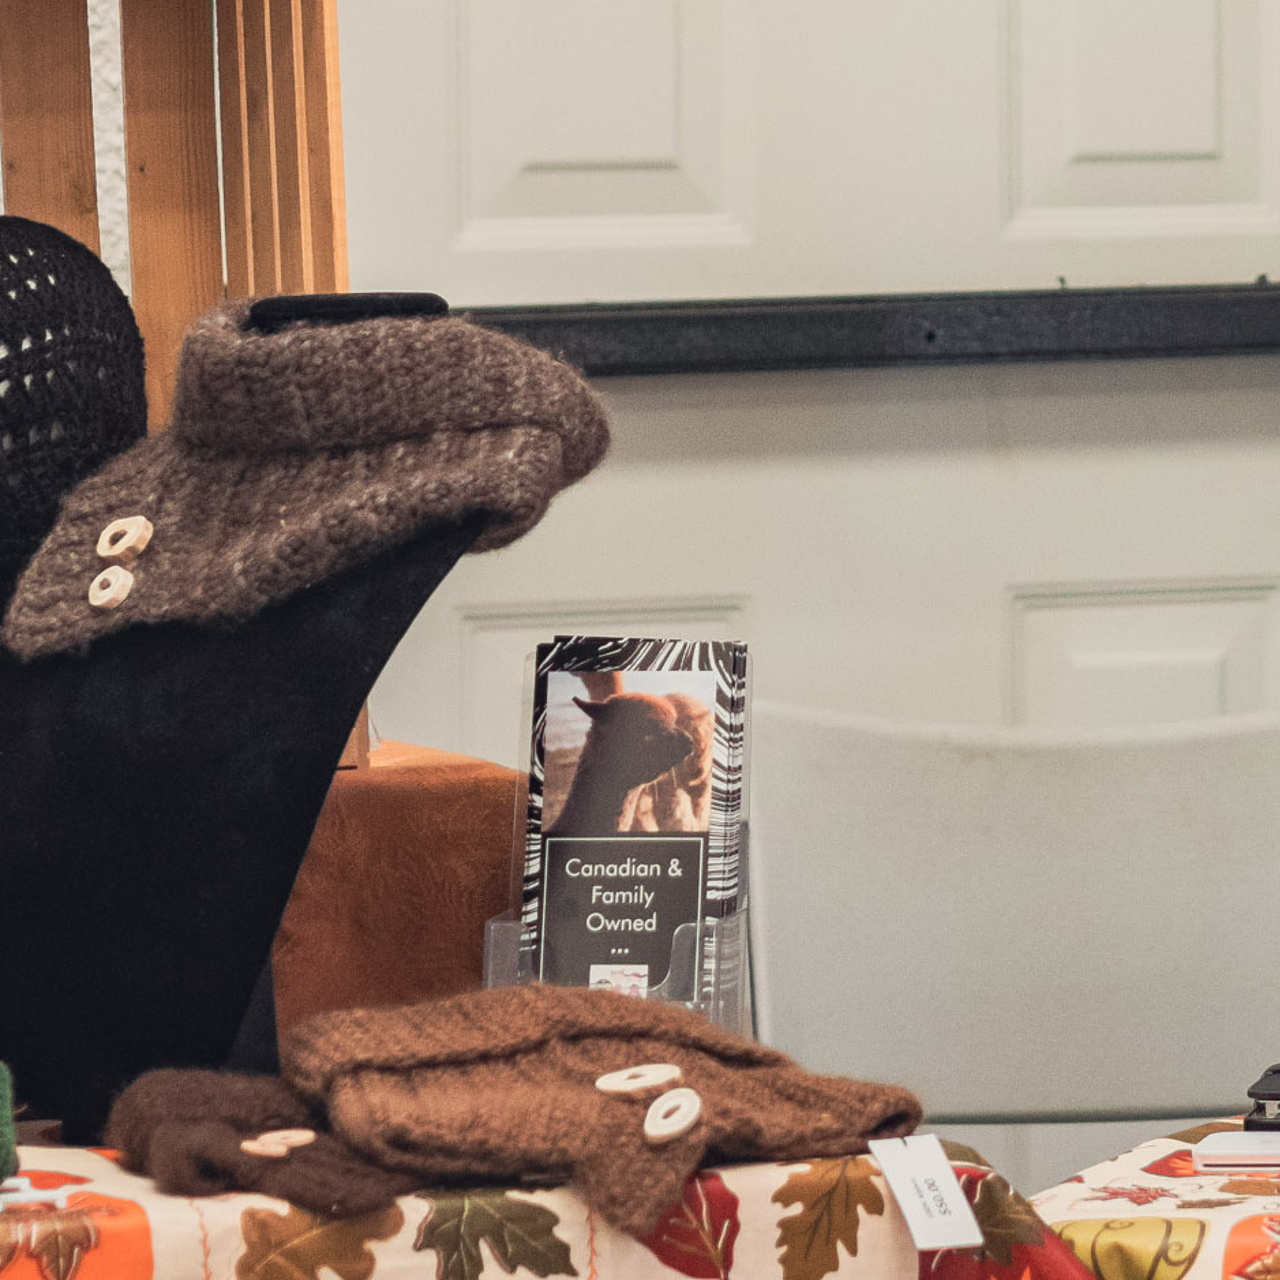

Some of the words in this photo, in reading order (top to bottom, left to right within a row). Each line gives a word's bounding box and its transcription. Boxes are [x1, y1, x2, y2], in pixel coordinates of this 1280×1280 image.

[565, 857, 661, 877] Canadian
[667, 858, 683, 877] &
[591, 884, 655, 909] Family
[586, 911, 657, 932] Owned
